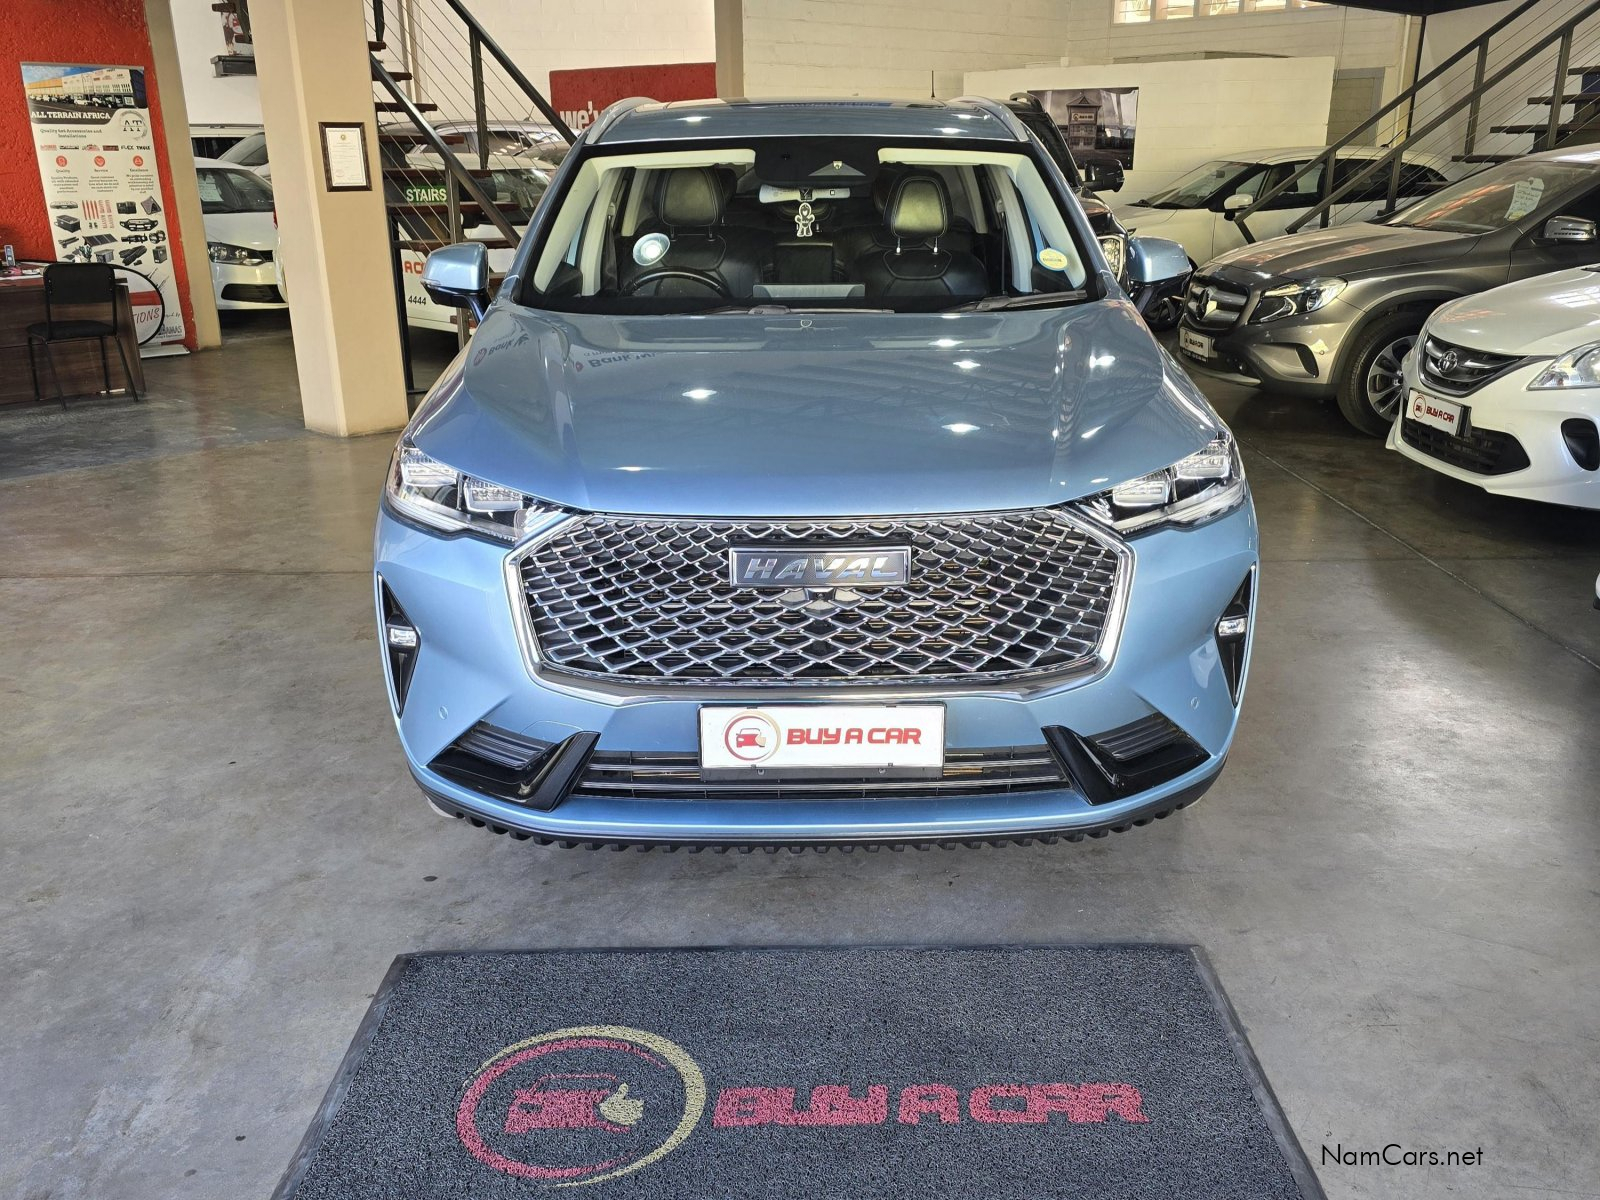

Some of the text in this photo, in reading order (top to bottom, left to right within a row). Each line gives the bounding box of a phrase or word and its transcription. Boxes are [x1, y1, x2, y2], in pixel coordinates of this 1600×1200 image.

[31, 111, 111, 120] ALL TERRAIN AFRICA
[406, 188, 447, 201] STAIRS
[408, 295, 426, 306] 4444
[133, 308, 160, 324] IONS
[1426, 406, 1438, 417] BUY
[1443, 412, 1454, 423] CAR
[743, 557, 898, 580] HAVAL
[786, 727, 922, 745] BUY A CAR
[713, 1083, 1151, 1127] BUY A CAR
